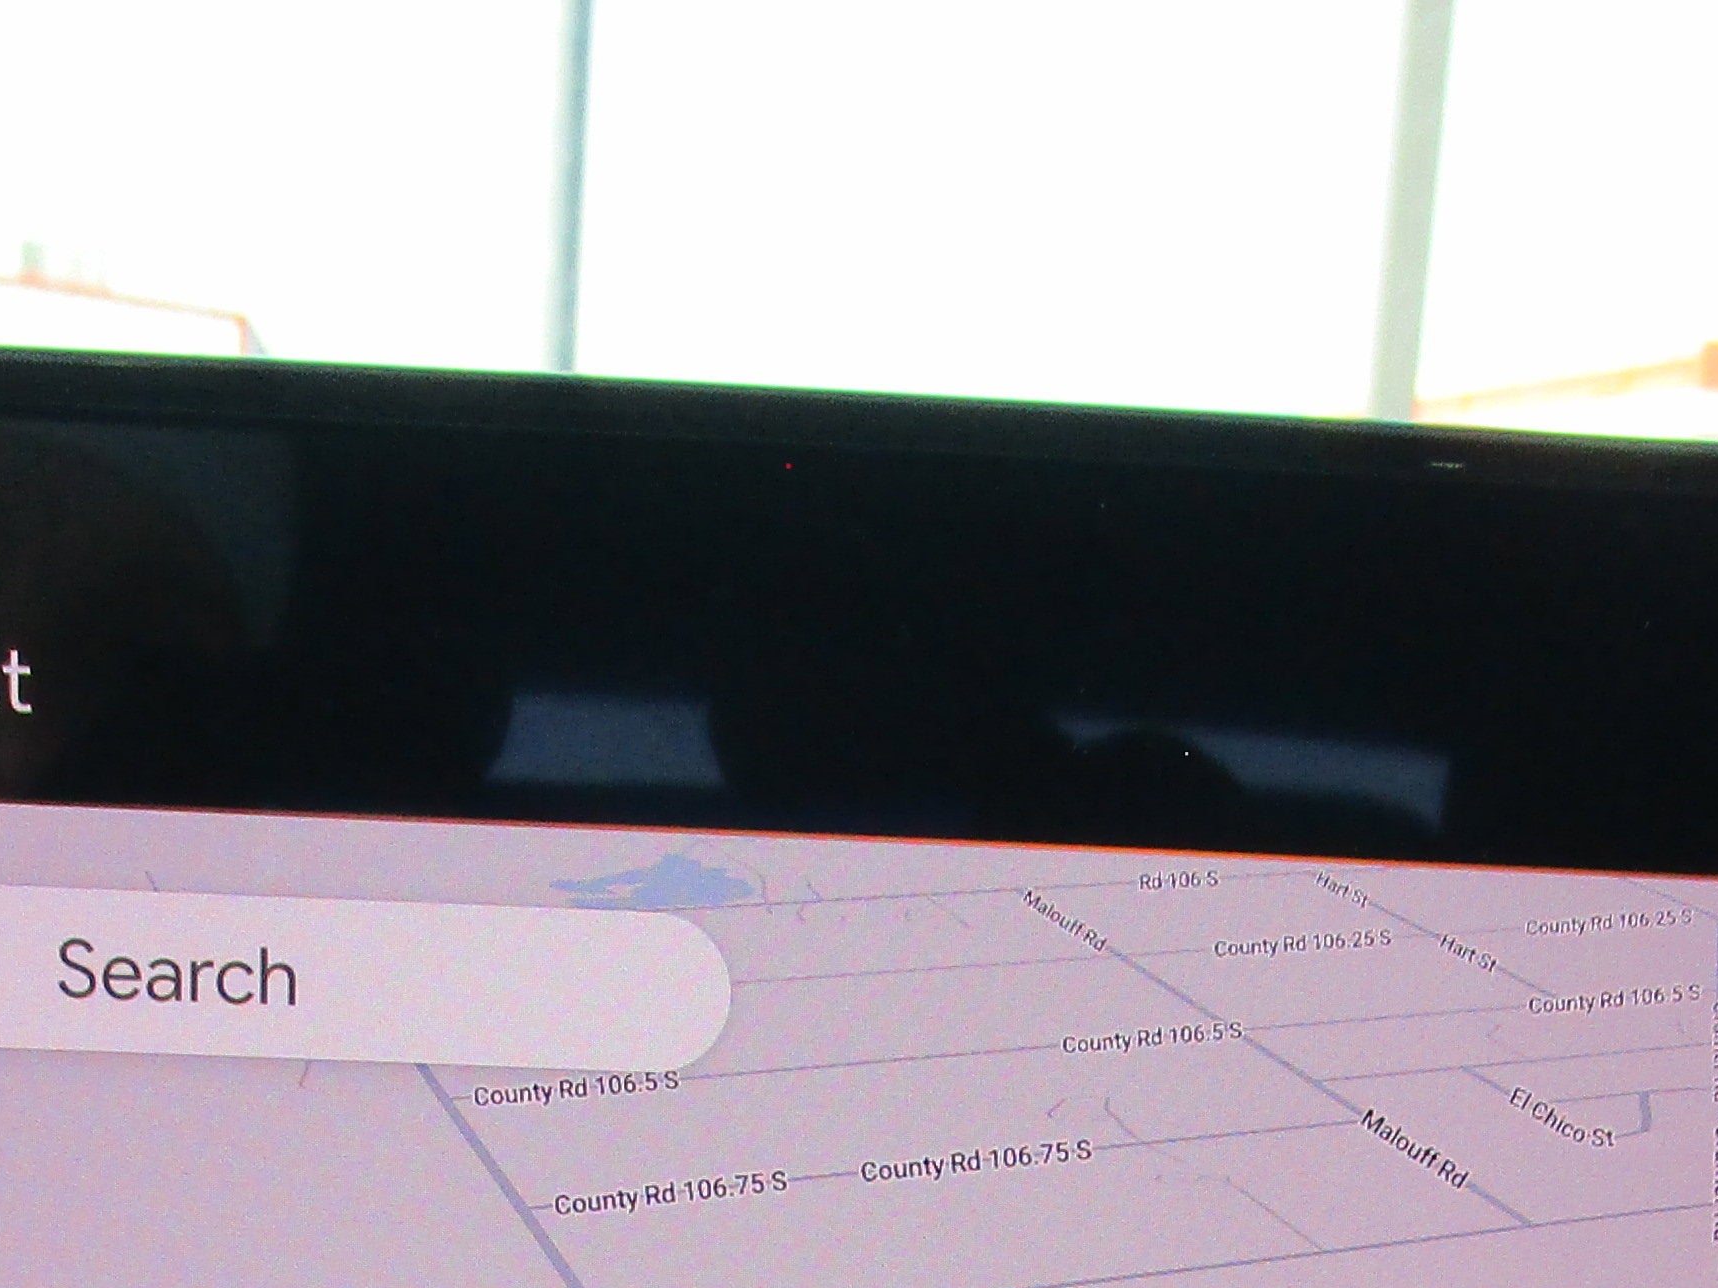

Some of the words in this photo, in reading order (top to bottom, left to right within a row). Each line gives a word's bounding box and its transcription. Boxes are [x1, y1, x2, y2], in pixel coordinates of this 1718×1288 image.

[1139, 873, 1162, 890] Rd
[1169, 871, 1201, 889] 106
[1205, 870, 1218, 887] S
[1351, 889, 1368, 908] St
[1022, 890, 1085, 937] Malouff
[1082, 927, 1107, 951] Rd
[1526, 918, 1586, 937] County
[1589, 913, 1613, 931] Rd
[1680, 909, 1692, 925] S
[1214, 937, 1279, 958] County
[1282, 935, 1307, 953] Rd
[1312, 930, 1375, 950] 106.25
[1377, 929, 1392, 947] S
[1439, 934, 1479, 963] Hart
[1479, 952, 1497, 974] St
[59, 939, 297, 1005] Search
[1528, 995, 1596, 1014] County
[1599, 991, 1625, 1008] Rd
[1687, 984, 1701, 1001] S
[1062, 1034, 1132, 1057] County
[1137, 1029, 1163, 1047] Rd
[1168, 1024, 1224, 1044] 106.5
[1227, 1022, 1243, 1039] S
[473, 1081, 553, 1108] County
[558, 1076, 588, 1098] Rd
[594, 1072, 658, 1096] 106.5
[662, 1070, 680, 1090] S
[1510, 1087, 1531, 1111] El
[1532, 1098, 1587, 1141] Chico
[1592, 1126, 1613, 1146] St
[860, 1156, 945, 1184] County
[949, 1149, 981, 1172] Rd
[988, 1142, 1071, 1170] 106.75
[1075, 1139, 1093, 1161] S
[1360, 1109, 1441, 1168] Malouff
[1436, 1157, 1469, 1189] Rd
[553, 1188, 640, 1217] County
[643, 1181, 676, 1204] Rd
[683, 1173, 766, 1201] 106.75
[770, 1170, 788, 1192] S
